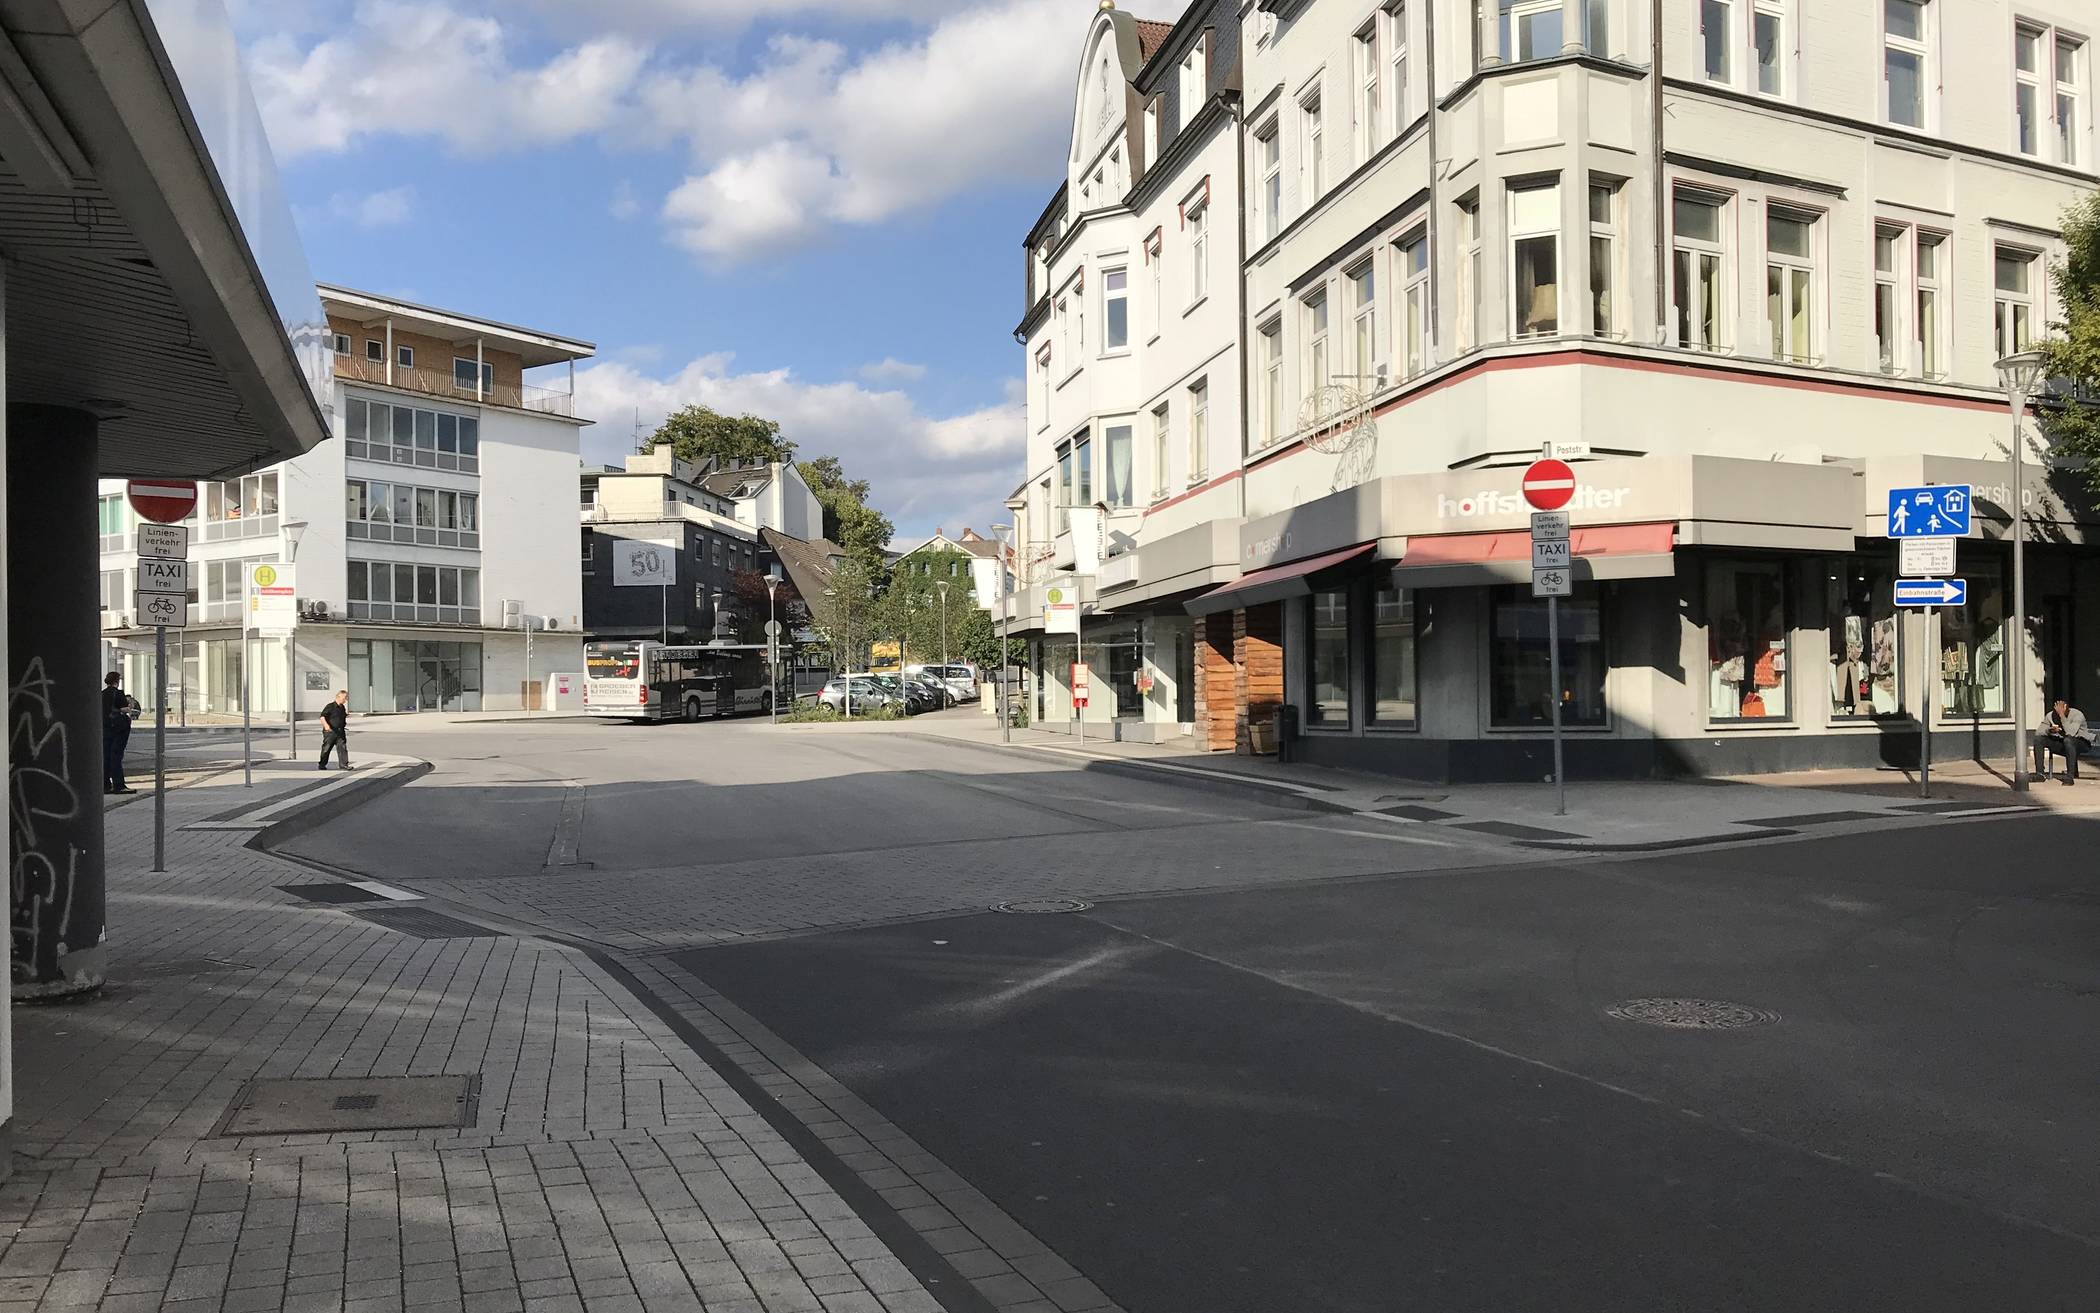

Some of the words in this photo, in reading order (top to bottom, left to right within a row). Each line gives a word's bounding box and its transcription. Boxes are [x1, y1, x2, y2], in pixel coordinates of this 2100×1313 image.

[1536, 522, 1564, 530] verkehr
[147, 528, 179, 537] Linien-
[145, 538, 181, 547] verkehr
[155, 547, 171, 555] frei
[1538, 544, 1566, 556] TAXI
[144, 563, 182, 578] TAXI
[155, 580, 171, 588] frei
[1545, 585, 1558, 593] frei
[154, 614, 170, 623] frei
